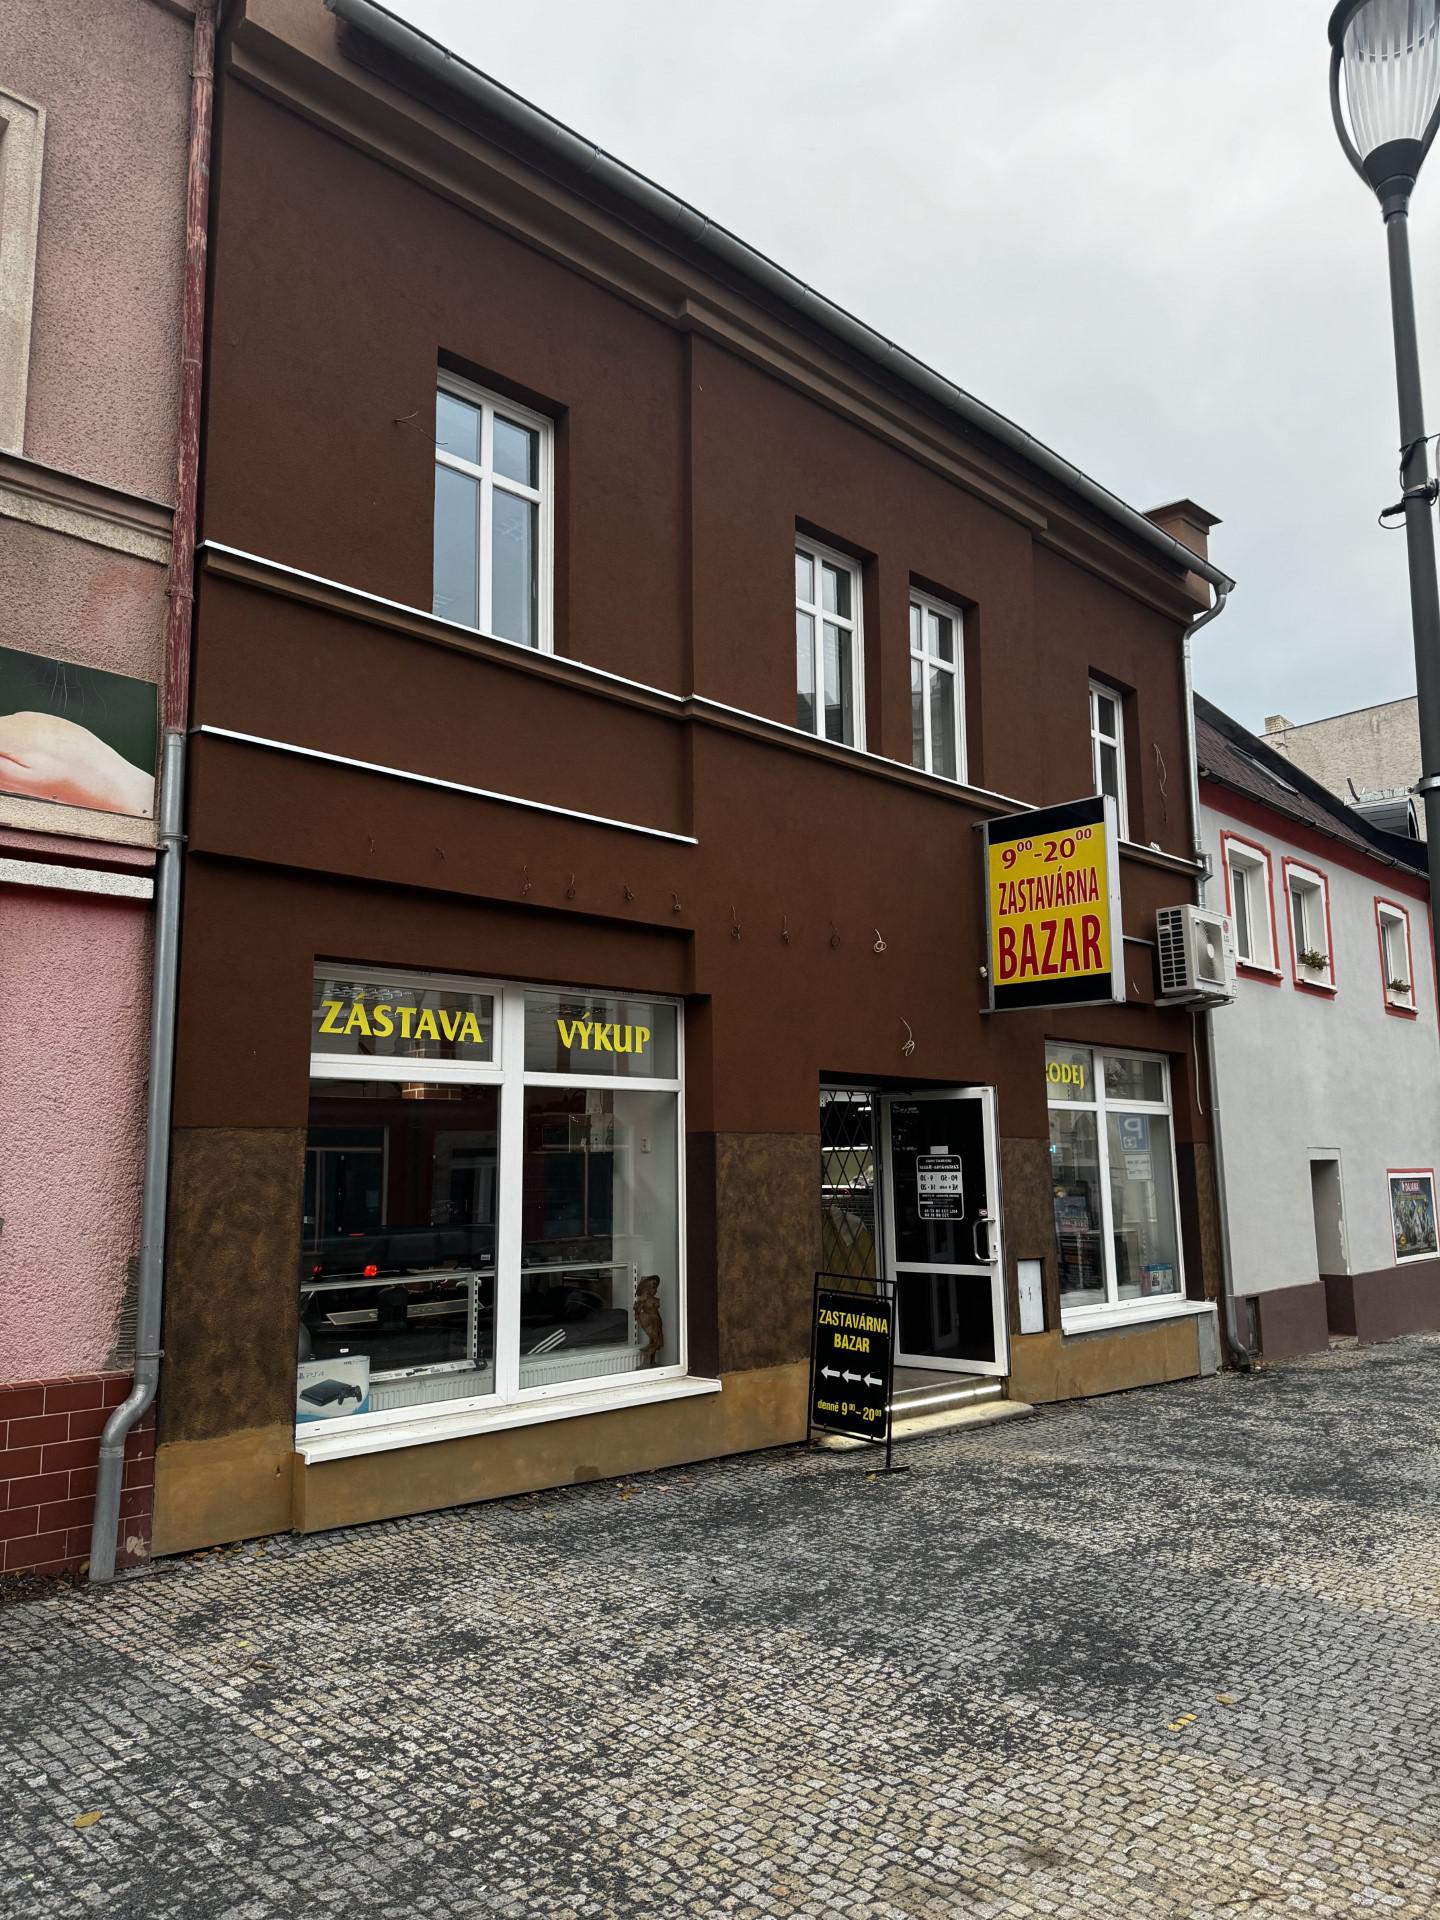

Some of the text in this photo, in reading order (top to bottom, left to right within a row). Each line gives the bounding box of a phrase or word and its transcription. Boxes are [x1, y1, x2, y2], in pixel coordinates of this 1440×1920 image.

[998, 865, 1100, 916] ZASTAVÁRNA
[998, 914, 1104, 980] BAZAR
[318, 992, 484, 1043] ZÁSTAVA
[556, 1011, 651, 1054] VÝKUP
[1046, 1062, 1085, 1089] ODEJ
[819, 1309, 888, 1334] ZASTAVÁRNA
[834, 1333, 870, 1353] BAZAR
[818, 1399, 839, 1412] denně
